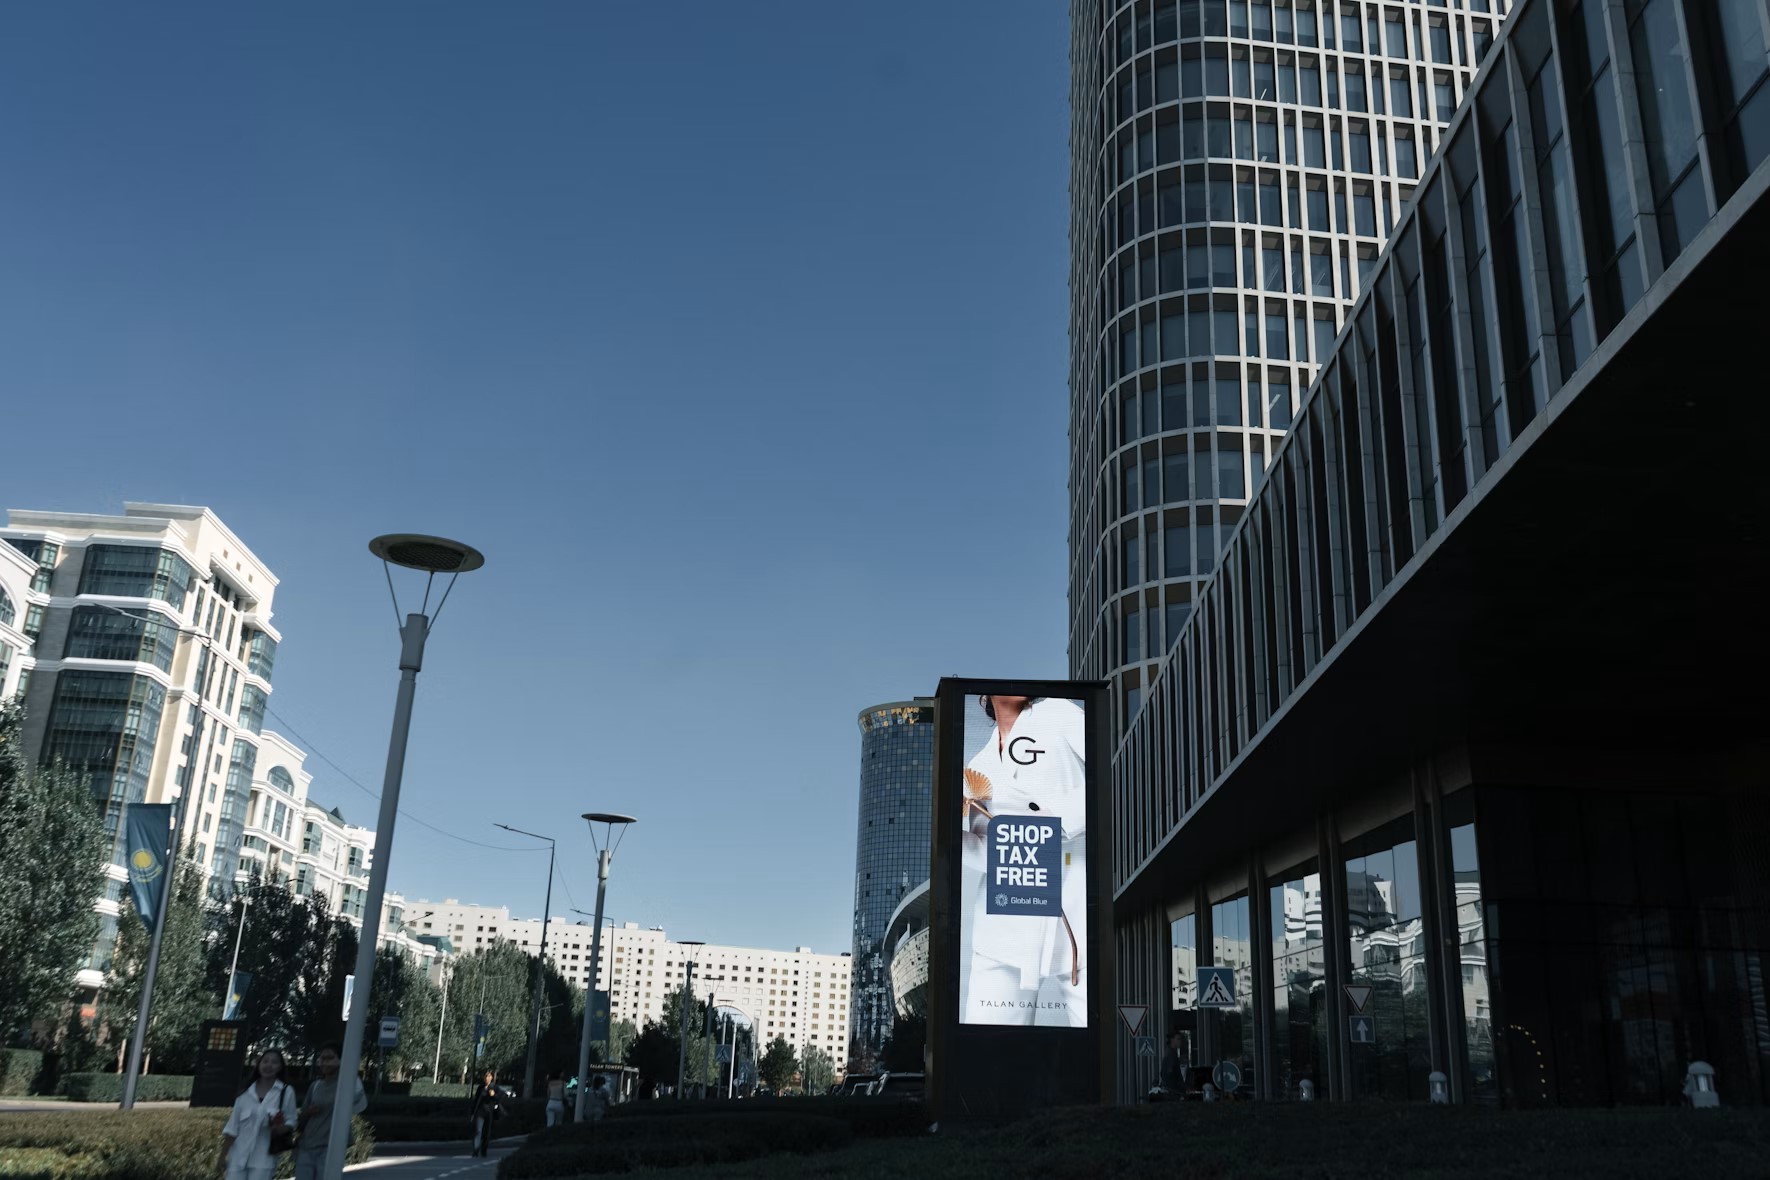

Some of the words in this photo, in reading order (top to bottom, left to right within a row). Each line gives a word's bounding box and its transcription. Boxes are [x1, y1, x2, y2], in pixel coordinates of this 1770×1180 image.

[996, 824, 1053, 844] SHOP
[996, 845, 1038, 865] TAX
[996, 867, 1048, 887] FREE
[1010, 896, 1031, 905] Global
[1032, 897, 1048, 905] Blue
[980, 1000, 1014, 1008] TALAN
[1019, 1001, 1067, 1009] GALLERY
